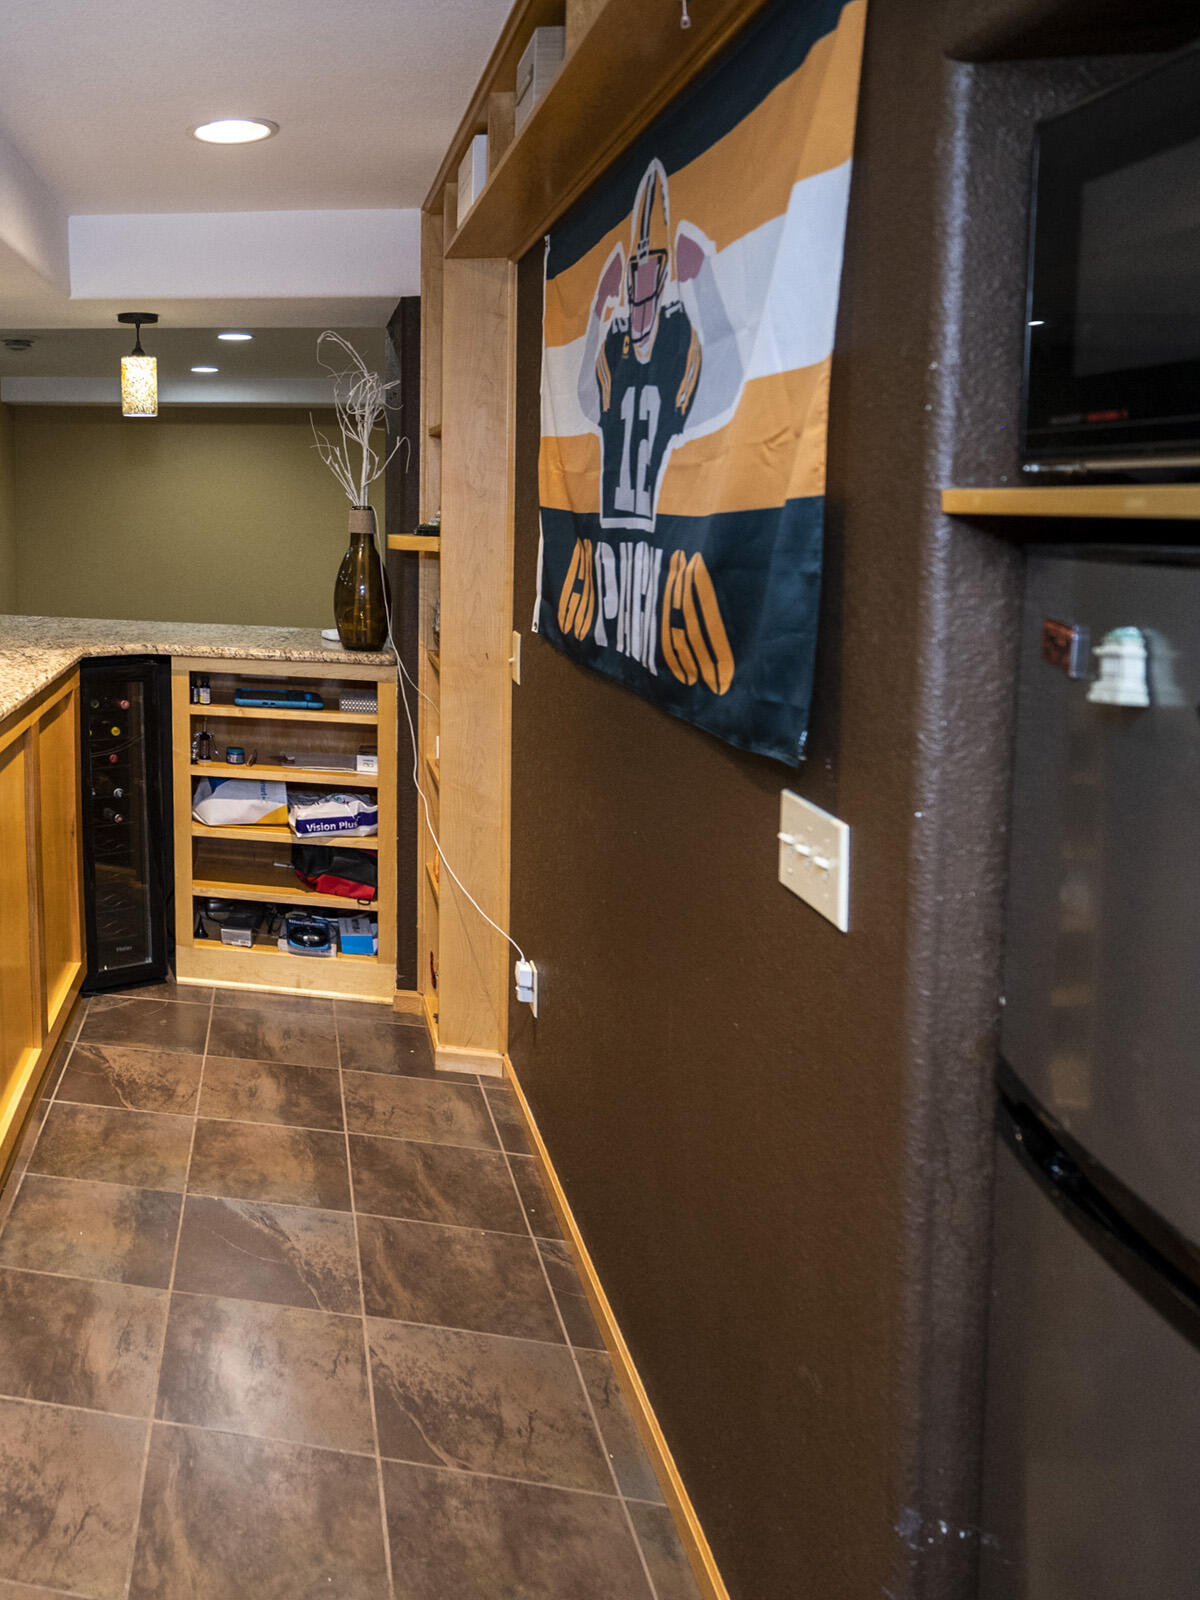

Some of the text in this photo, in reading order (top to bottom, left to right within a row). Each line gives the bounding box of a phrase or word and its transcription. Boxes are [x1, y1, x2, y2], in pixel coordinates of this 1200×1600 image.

[613, 384, 662, 518] 12
[557, 537, 736, 696] GO PACK GO
[305, 820, 359, 833] Vision Plus
